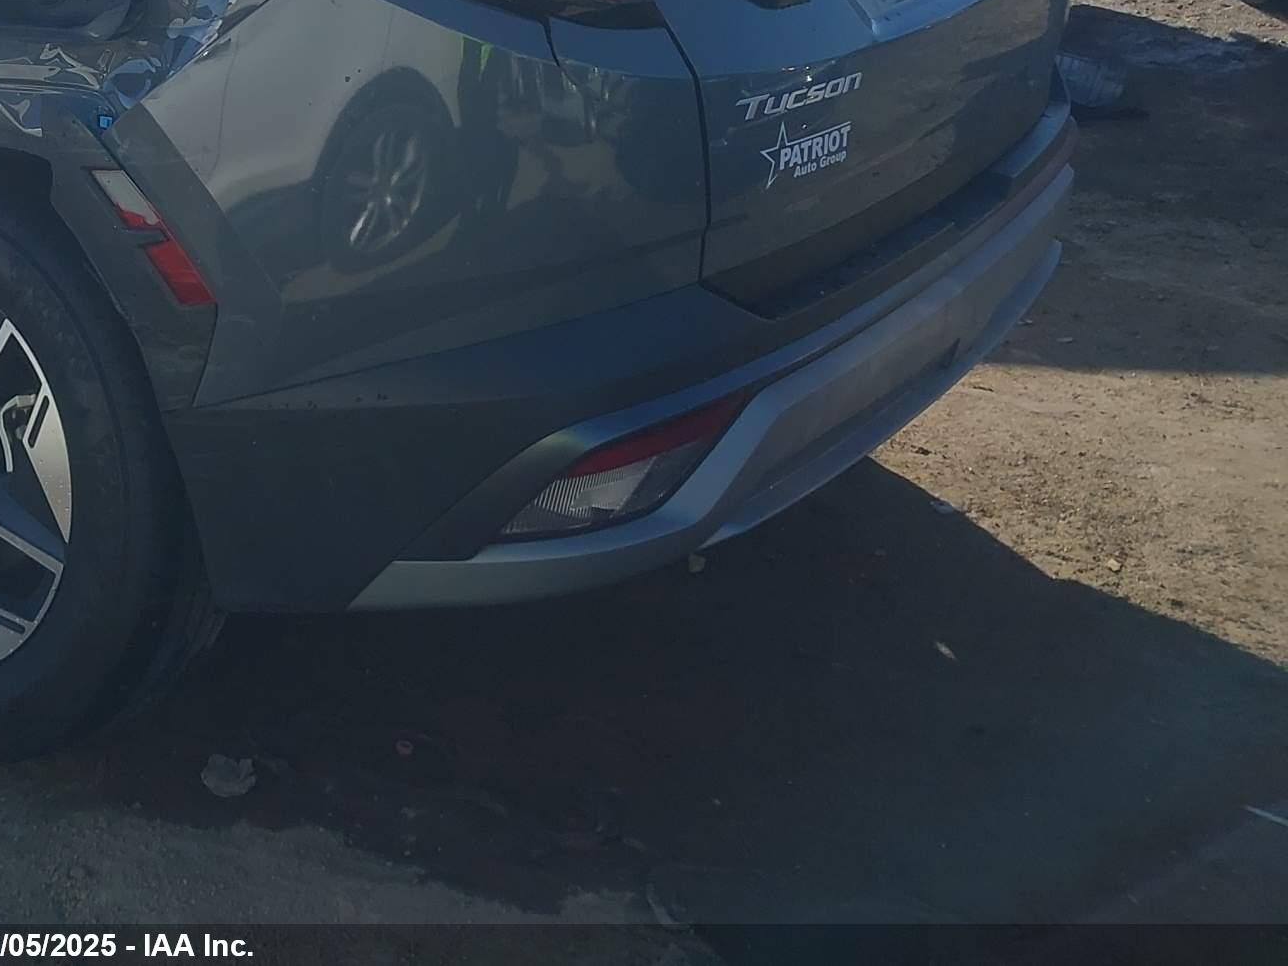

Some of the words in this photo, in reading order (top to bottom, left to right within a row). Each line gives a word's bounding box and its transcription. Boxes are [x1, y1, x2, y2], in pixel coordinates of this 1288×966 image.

[779, 125, 851, 171] PATRIOT
[793, 161, 817, 179] Auto
[819, 150, 847, 168] Group
